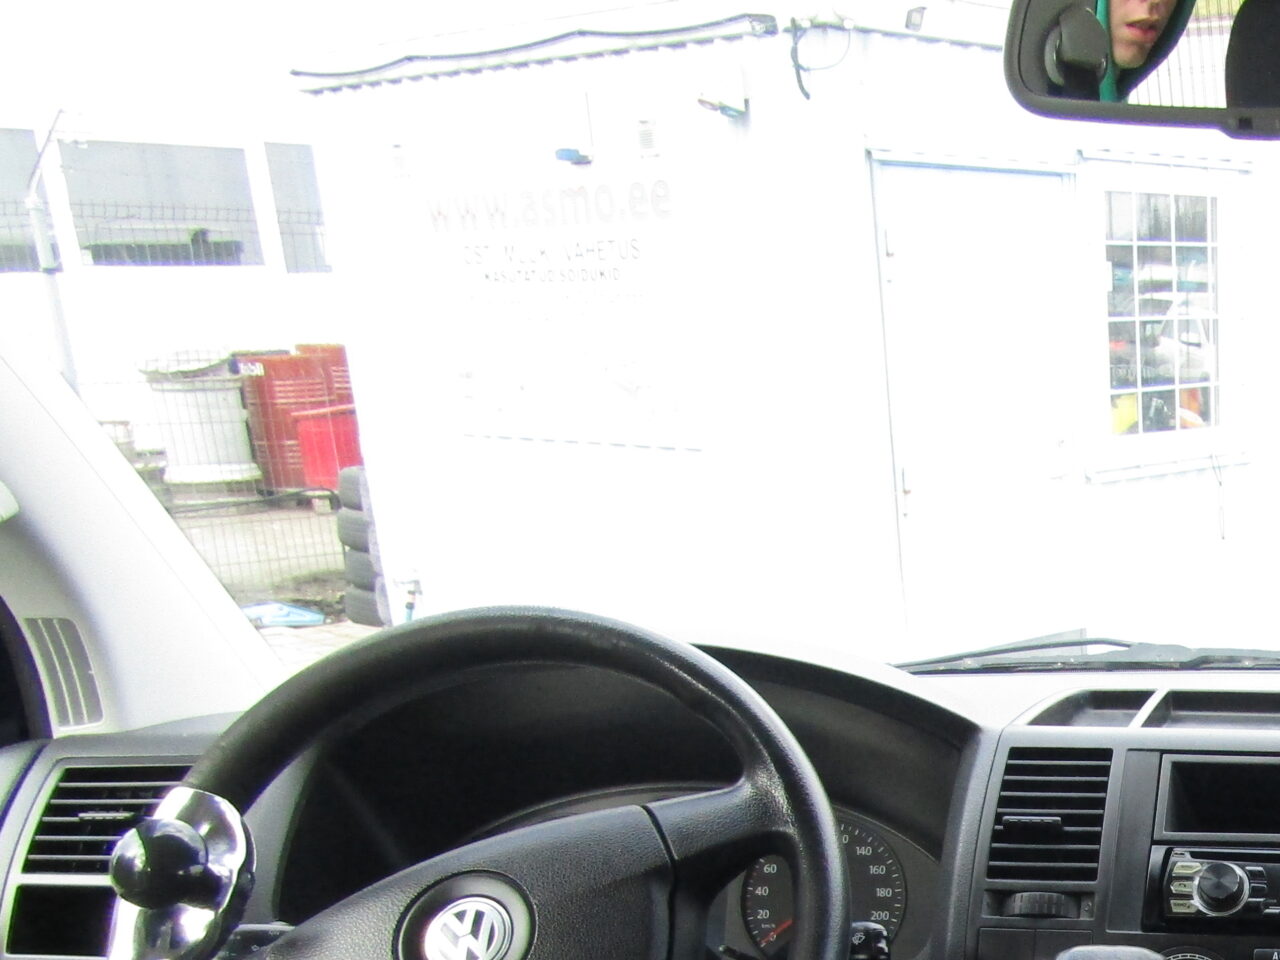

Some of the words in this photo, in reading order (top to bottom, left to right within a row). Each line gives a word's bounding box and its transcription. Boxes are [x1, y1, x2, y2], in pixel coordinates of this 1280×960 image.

[425, 178, 672, 232] www.asmo.ee
[855, 846, 872, 856] 140
[763, 864, 777, 874] 60
[869, 865, 886, 875] 160
[755, 886, 769, 896] 40
[876, 887, 892, 897] 180
[757, 909, 770, 919] 20
[870, 911, 890, 921] 200
